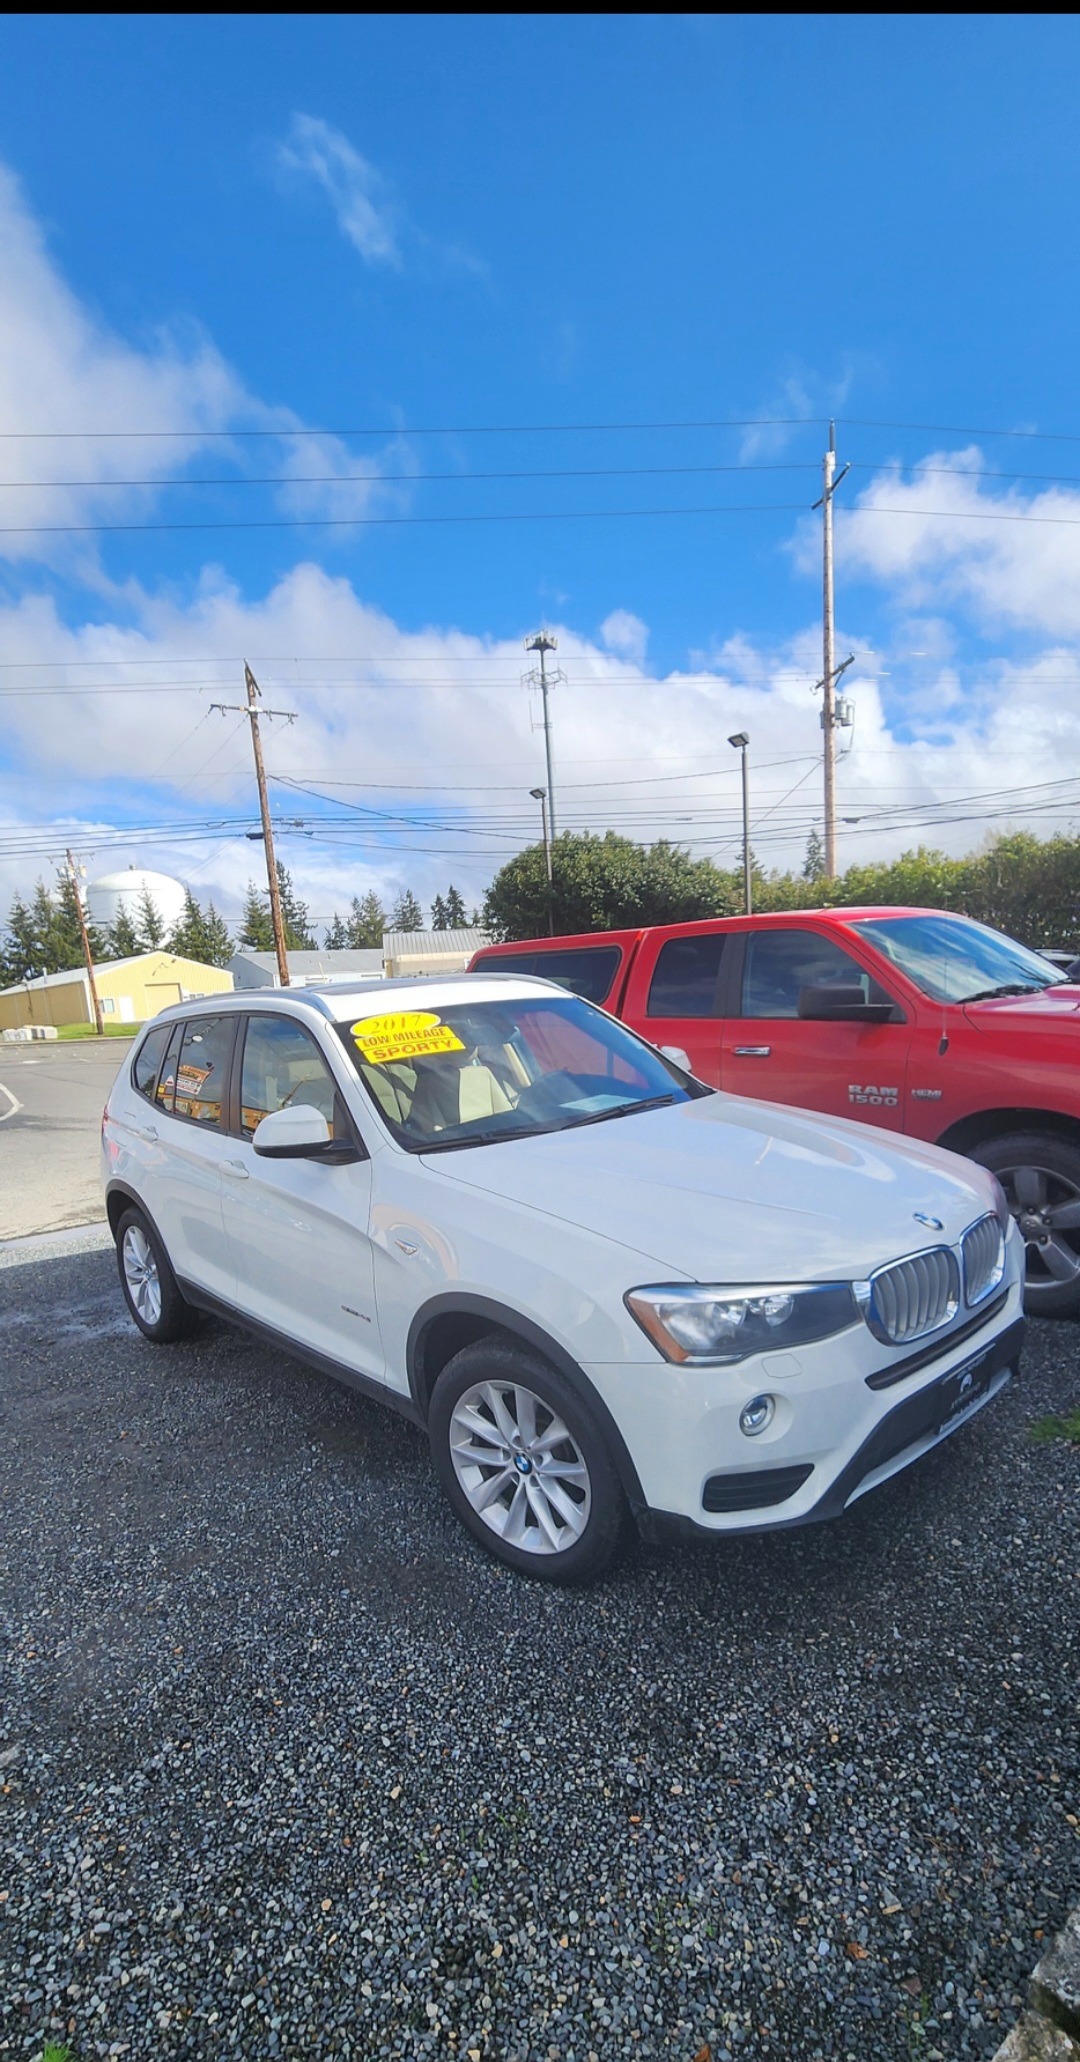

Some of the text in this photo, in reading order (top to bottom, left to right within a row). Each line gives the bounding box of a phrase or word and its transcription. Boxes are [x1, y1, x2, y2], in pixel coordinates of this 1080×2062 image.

[371, 1015, 421, 1034] 2017
[363, 1027, 446, 1047] LOW MILEAGE
[373, 1040, 453, 1059] SPORTY
[848, 1084, 899, 1096] RAM
[848, 1094, 898, 1106] 1500
